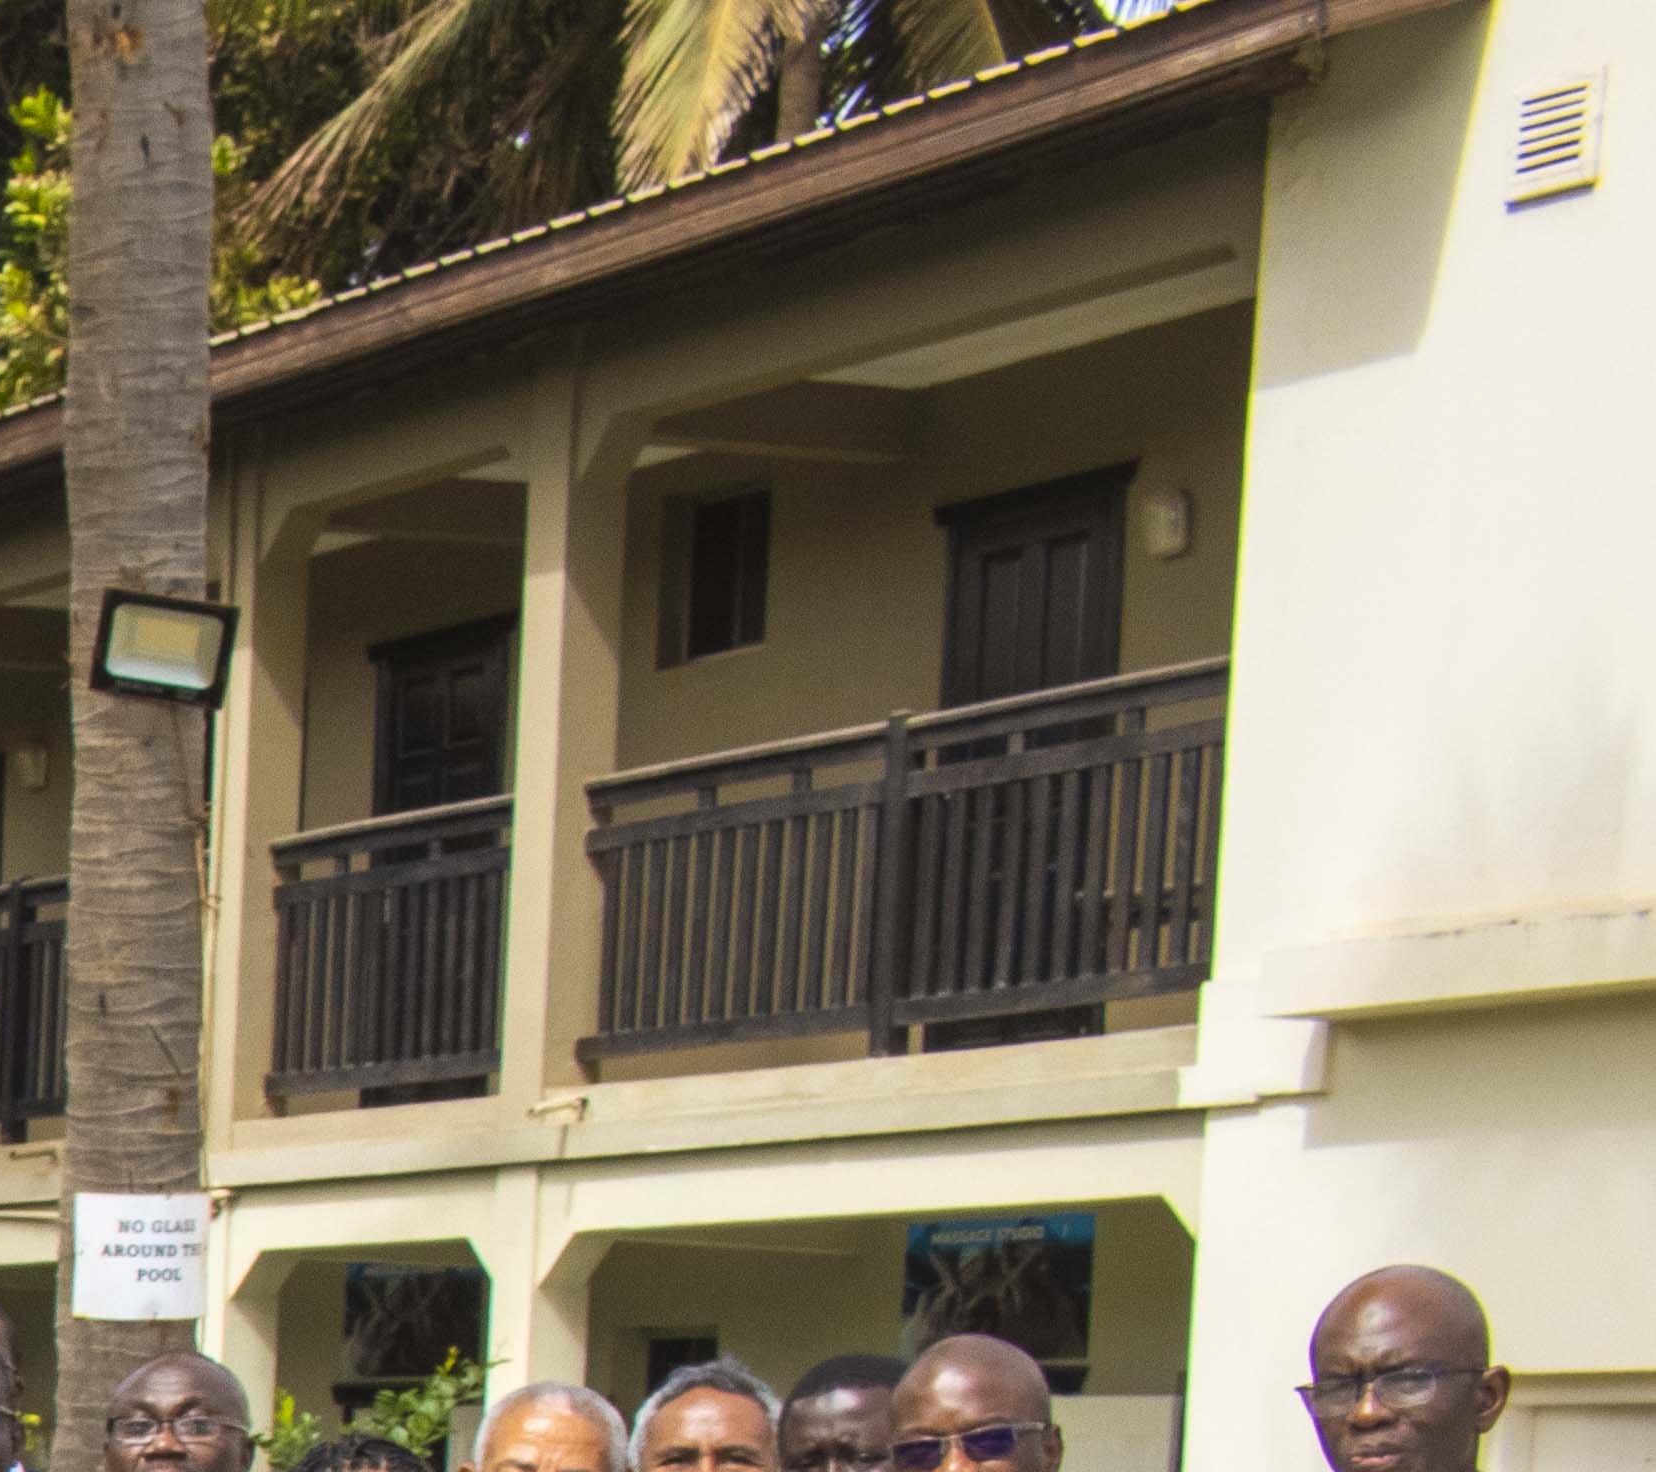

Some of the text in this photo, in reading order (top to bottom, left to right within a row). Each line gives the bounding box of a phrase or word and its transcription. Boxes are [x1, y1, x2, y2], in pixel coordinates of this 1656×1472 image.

[118, 1219, 145, 1233] NO
[101, 1244, 178, 1257] AROUND
[136, 1268, 183, 1281] POOL
